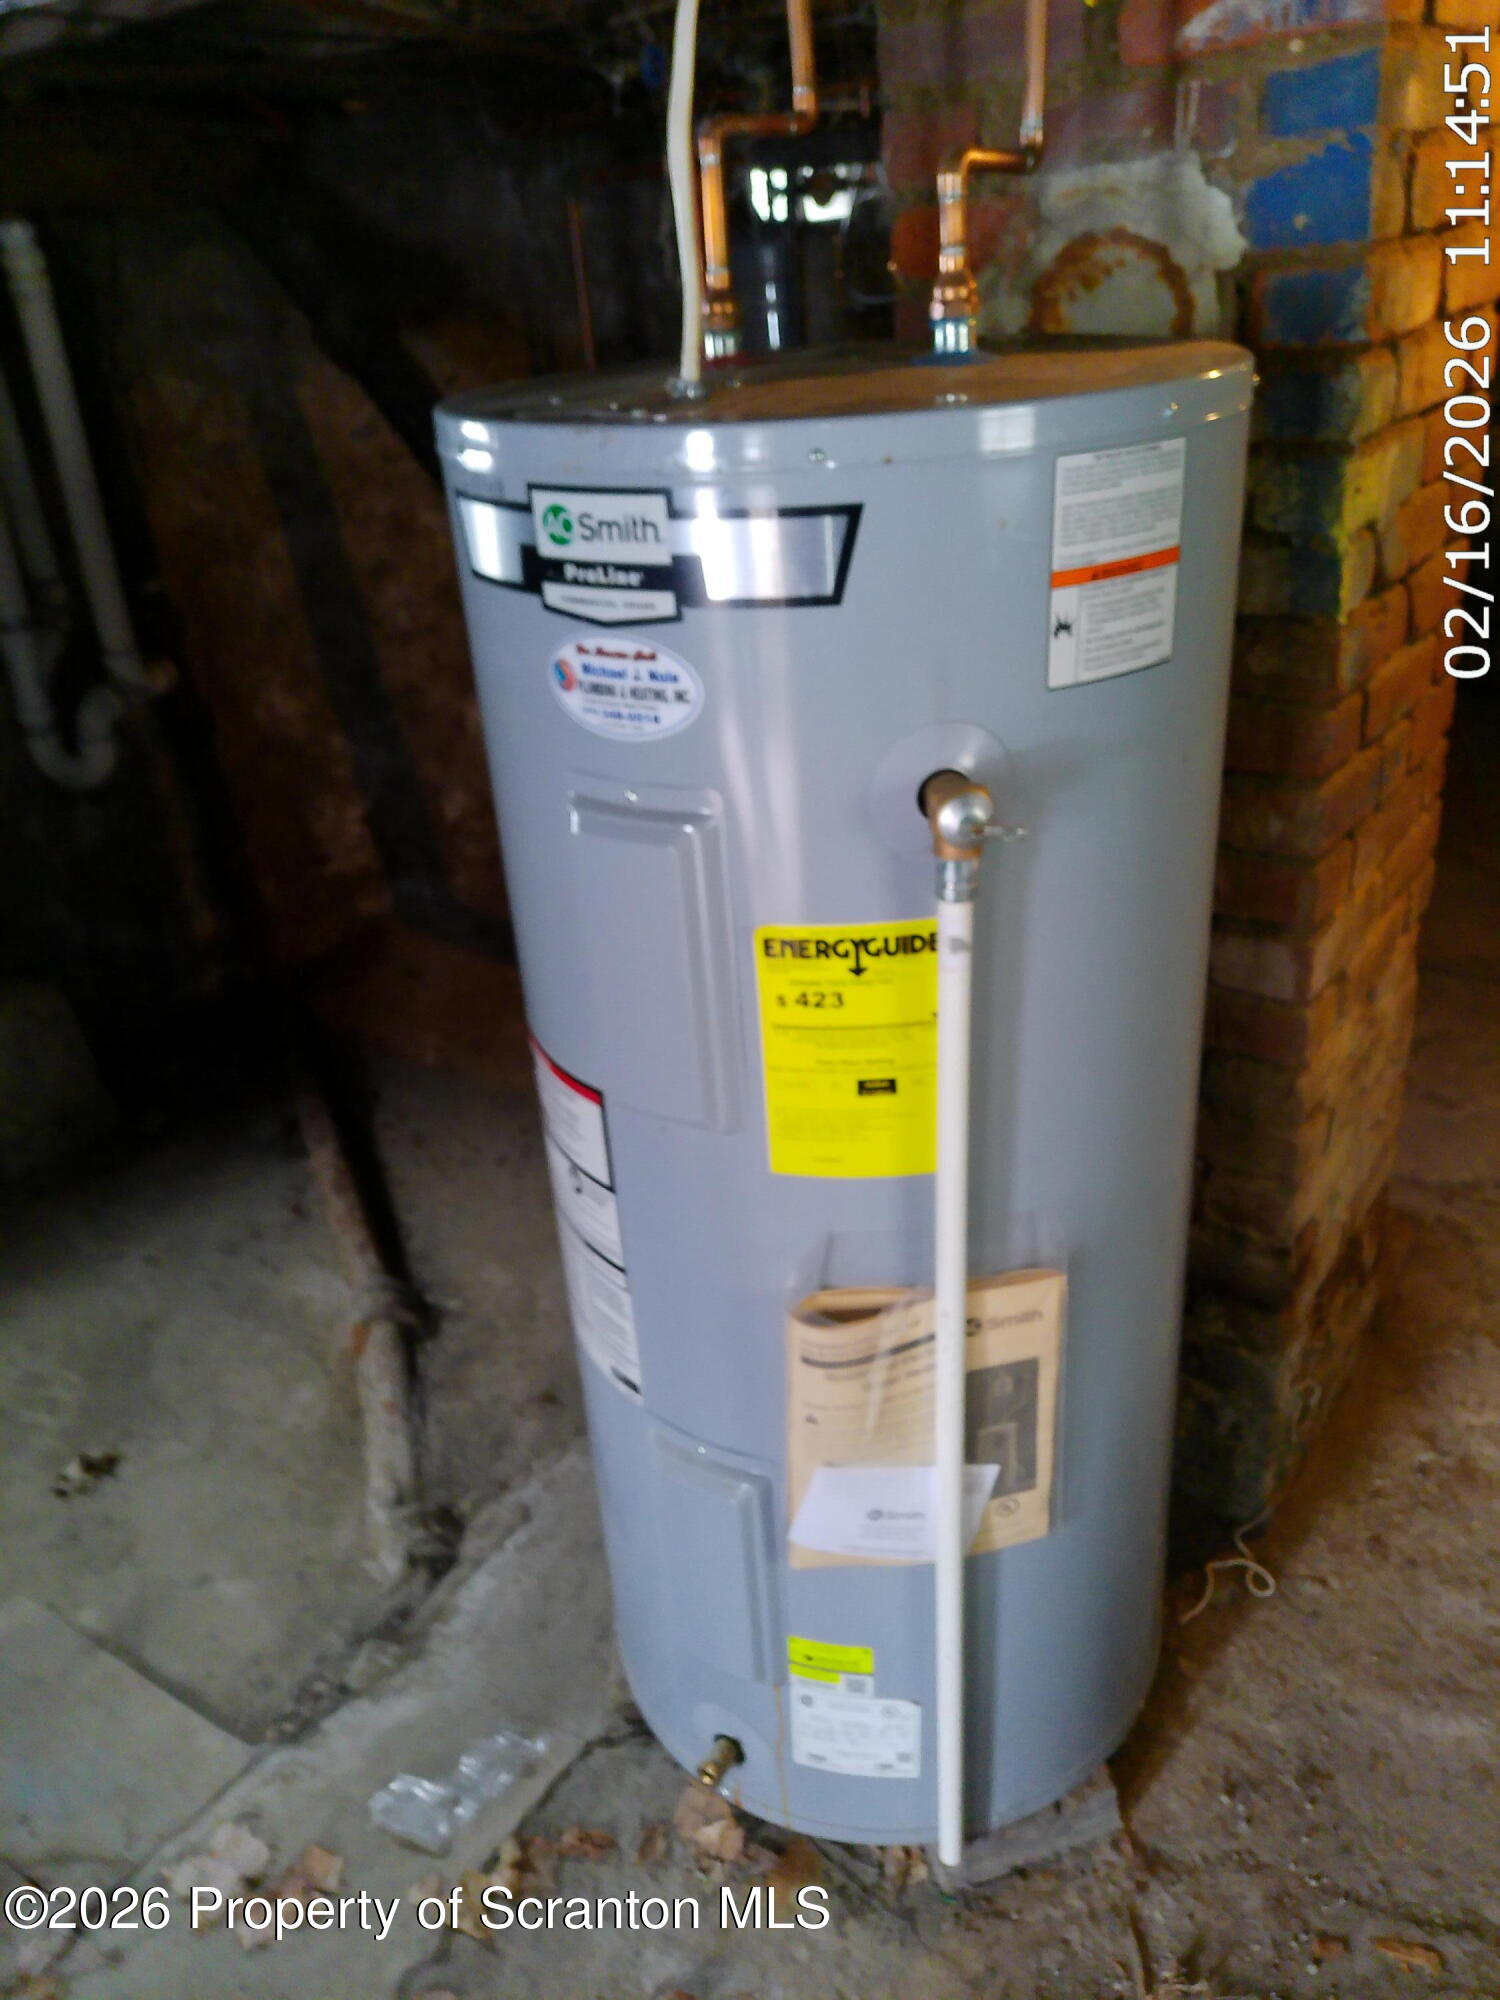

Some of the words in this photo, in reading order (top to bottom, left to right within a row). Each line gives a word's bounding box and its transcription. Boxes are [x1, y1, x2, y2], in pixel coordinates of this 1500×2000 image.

[578, 511, 661, 543] Smith
[563, 561, 643, 588] ProLine
[794, 990, 845, 1009] 423
